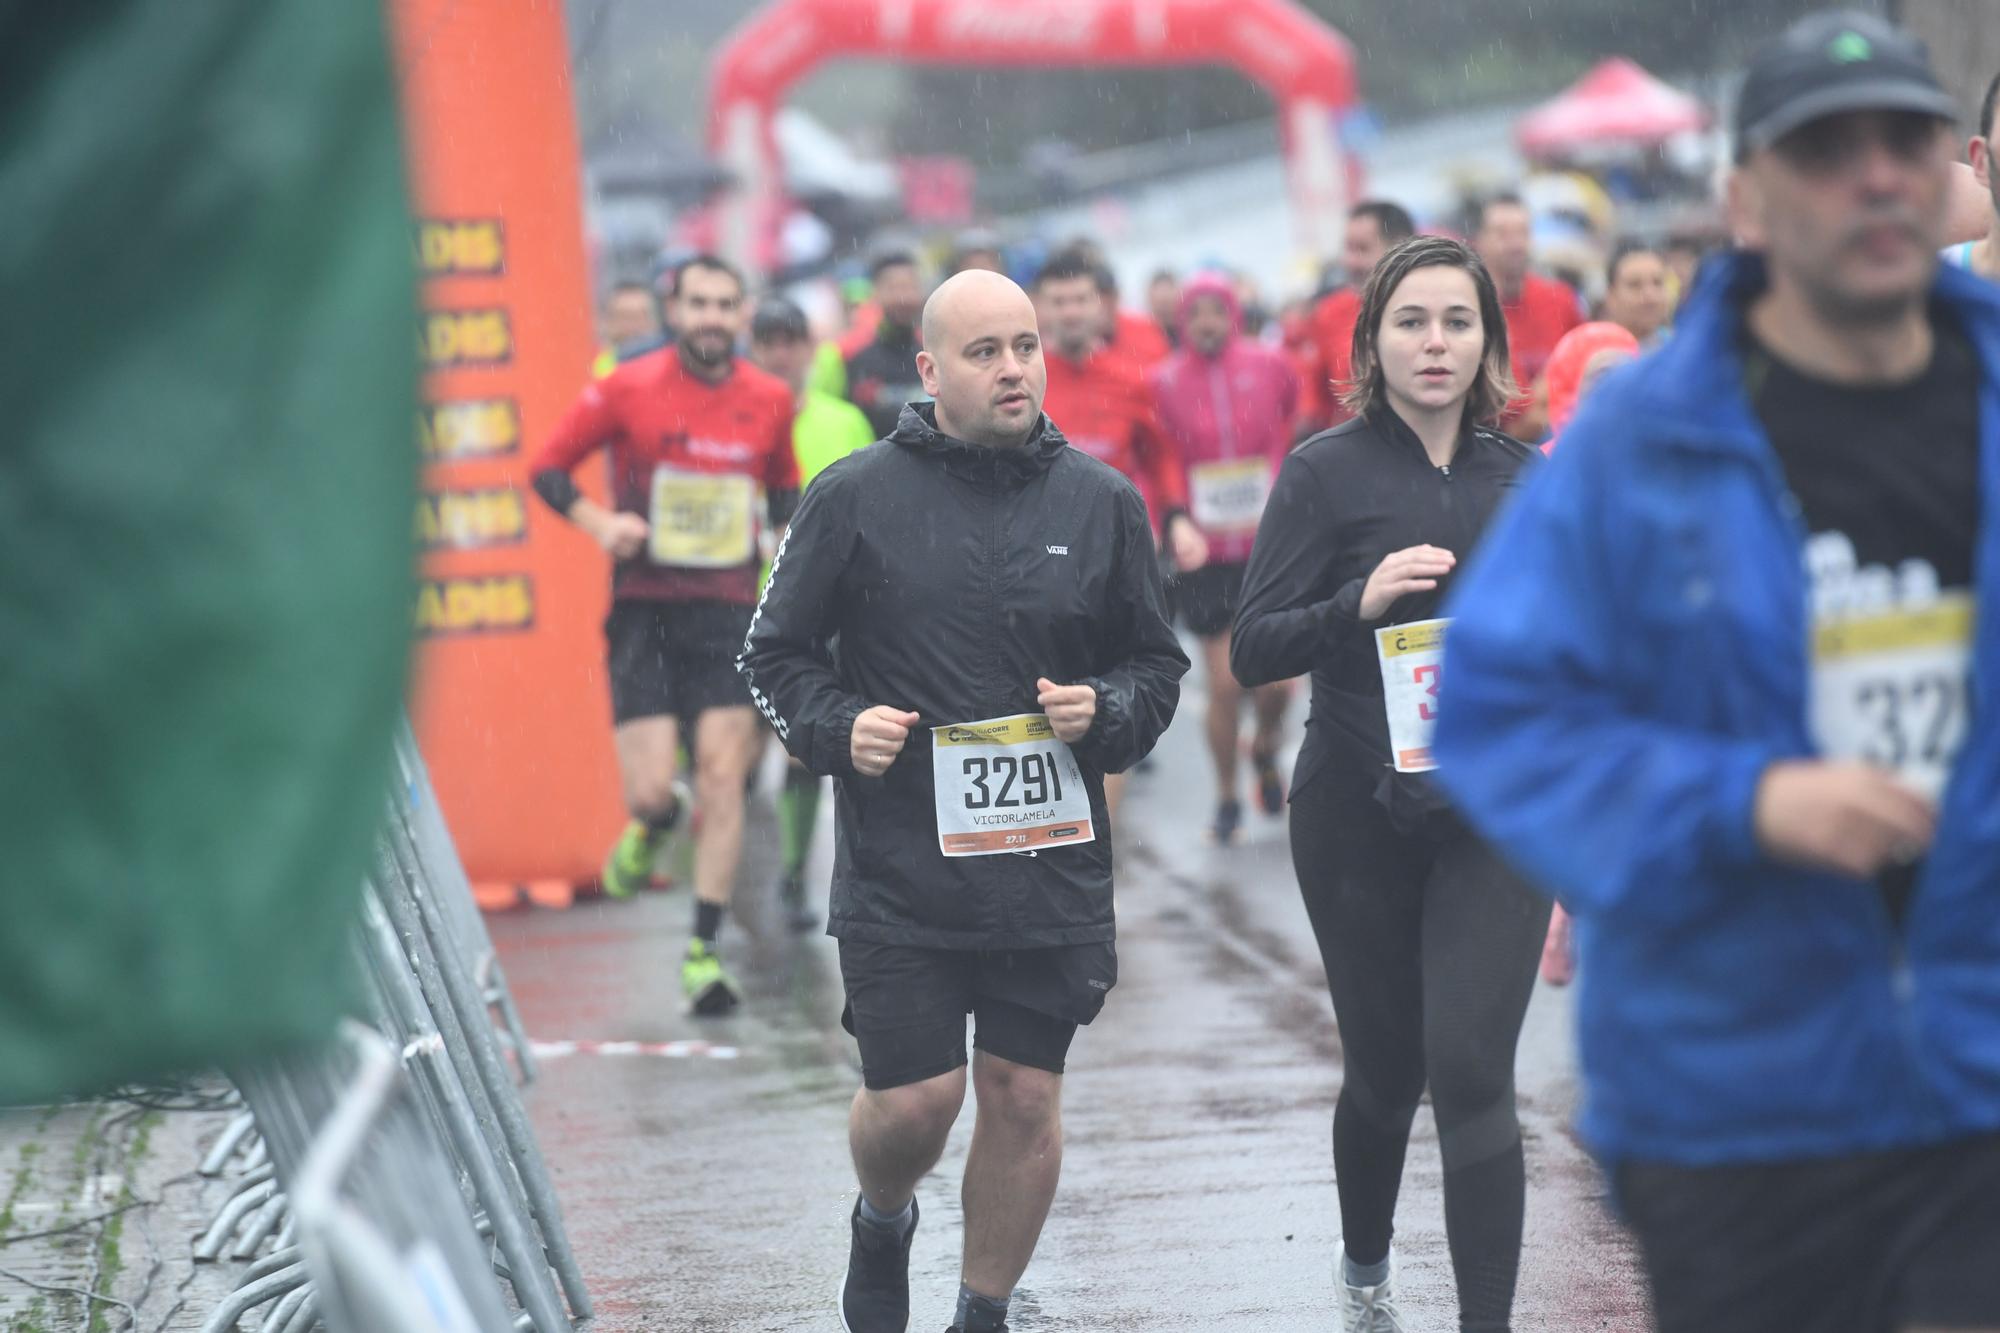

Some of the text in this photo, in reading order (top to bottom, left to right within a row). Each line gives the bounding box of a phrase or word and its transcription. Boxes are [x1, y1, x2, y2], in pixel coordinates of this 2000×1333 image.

[1046, 544, 1068, 556] VANS
[415, 577, 530, 629] ADIS
[1413, 663, 1442, 721] 3
[1856, 670, 1958, 768] 32
[963, 751, 1062, 810] 3291
[973, 810, 1056, 825] VICTORLAMELA
